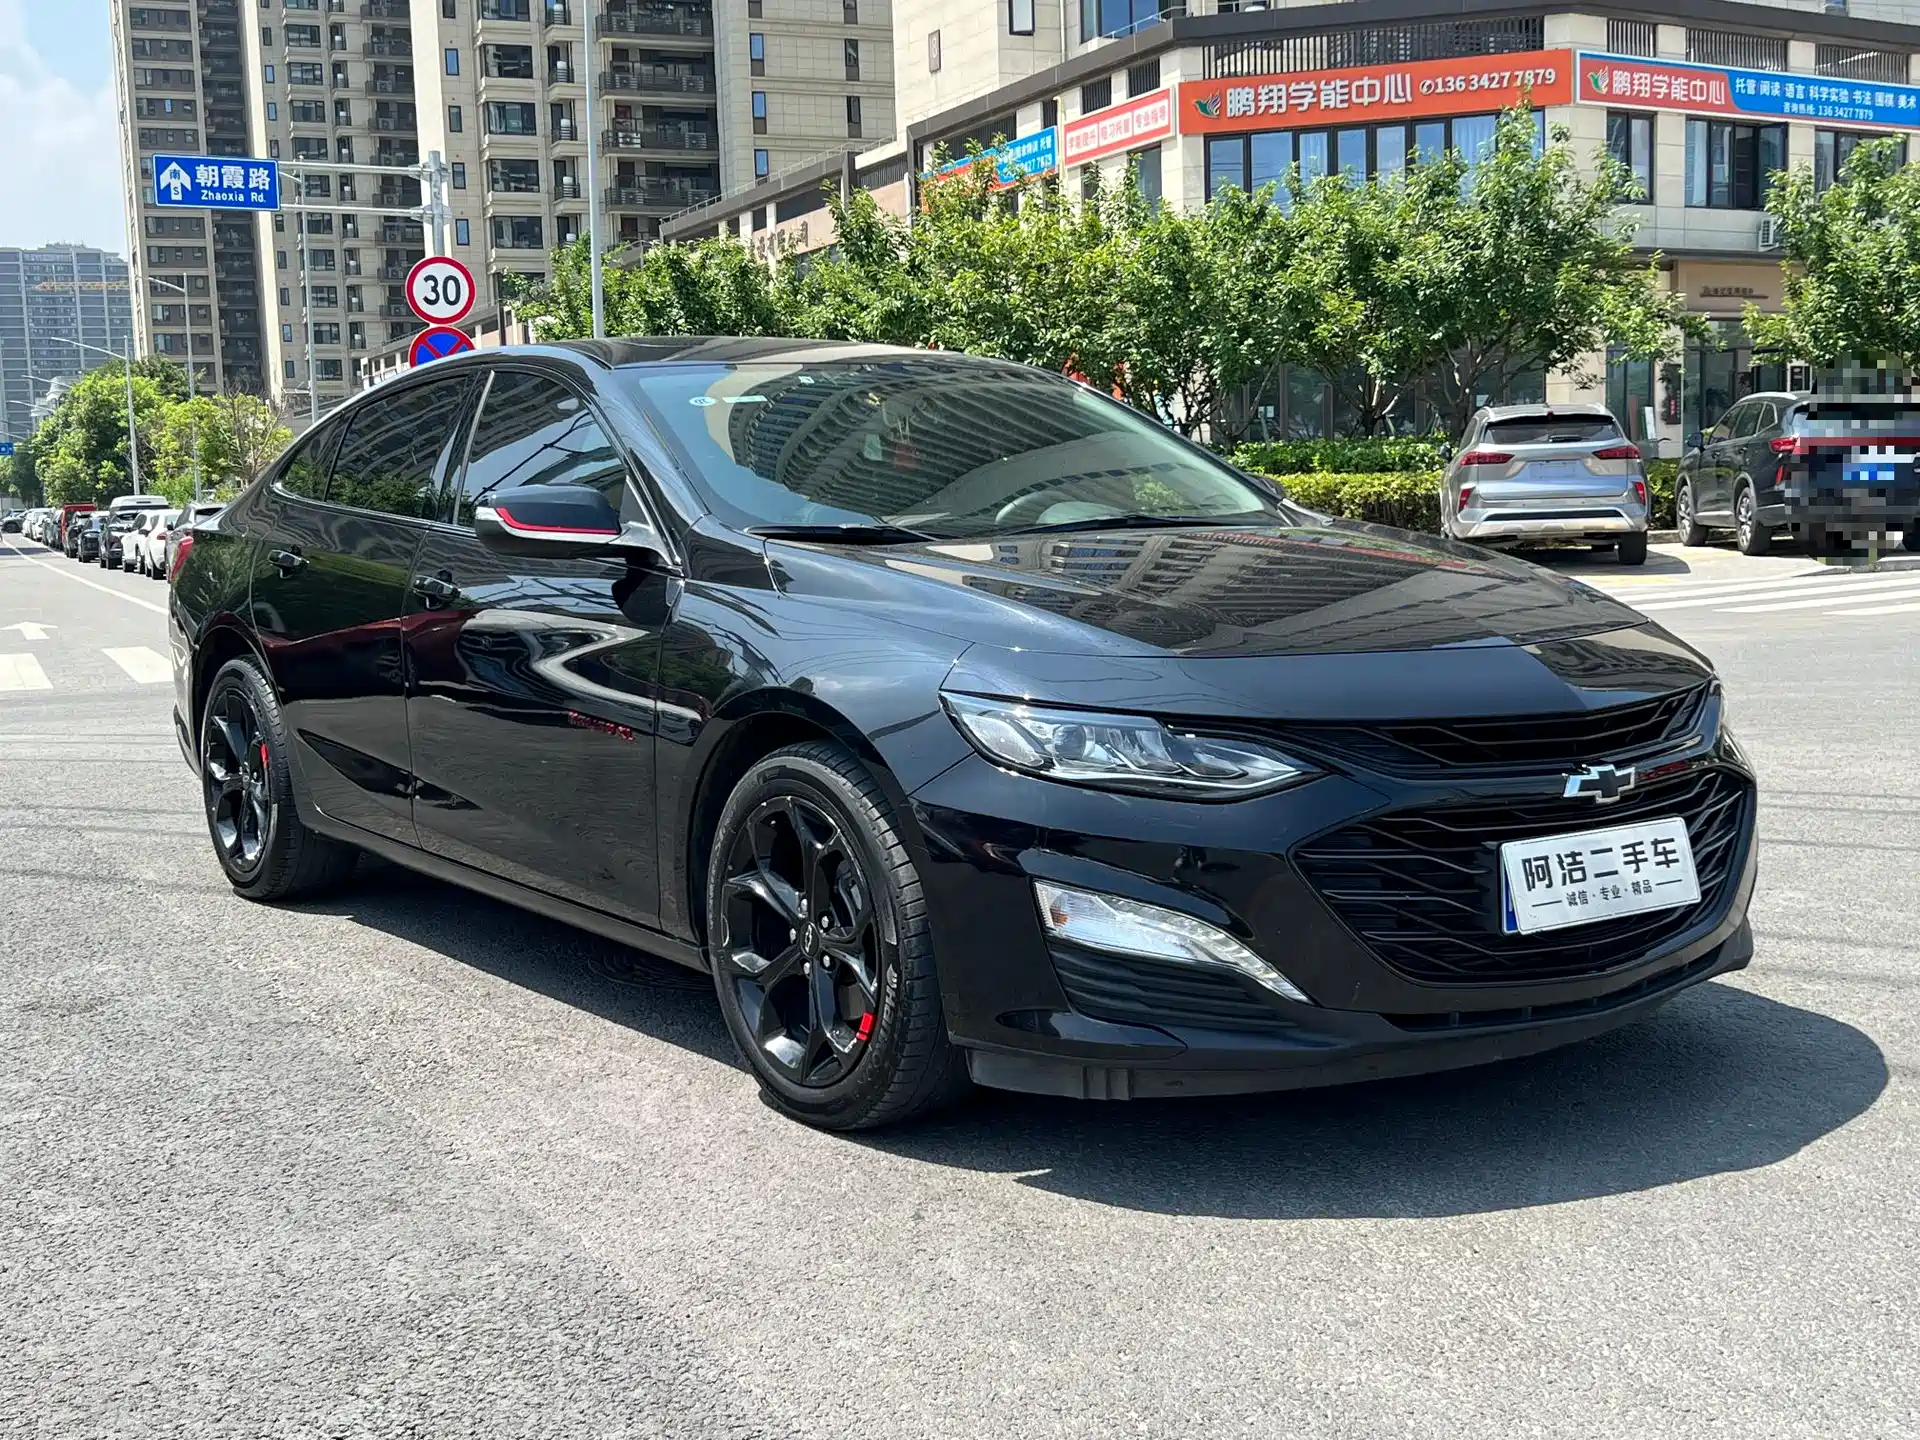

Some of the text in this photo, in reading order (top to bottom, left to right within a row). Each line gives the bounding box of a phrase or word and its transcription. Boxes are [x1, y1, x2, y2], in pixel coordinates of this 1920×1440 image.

[1226, 68, 1556, 118] 鹏翔学能中心 136 3427 7879
[1612, 70, 1725, 105] 鹏翔学能中心
[1735, 77, 1917, 110] 托管 阅读 语言 科学实验 书法 围棋 美术
[1818, 105, 1833, 116] 136
[1834, 106, 1854, 118] 3427
[1854, 108, 1873, 120] 7879
[195, 164, 271, 191] 朝霞路
[201, 189, 245, 202] Zhaoxia
[423, 274, 461, 306] 30
